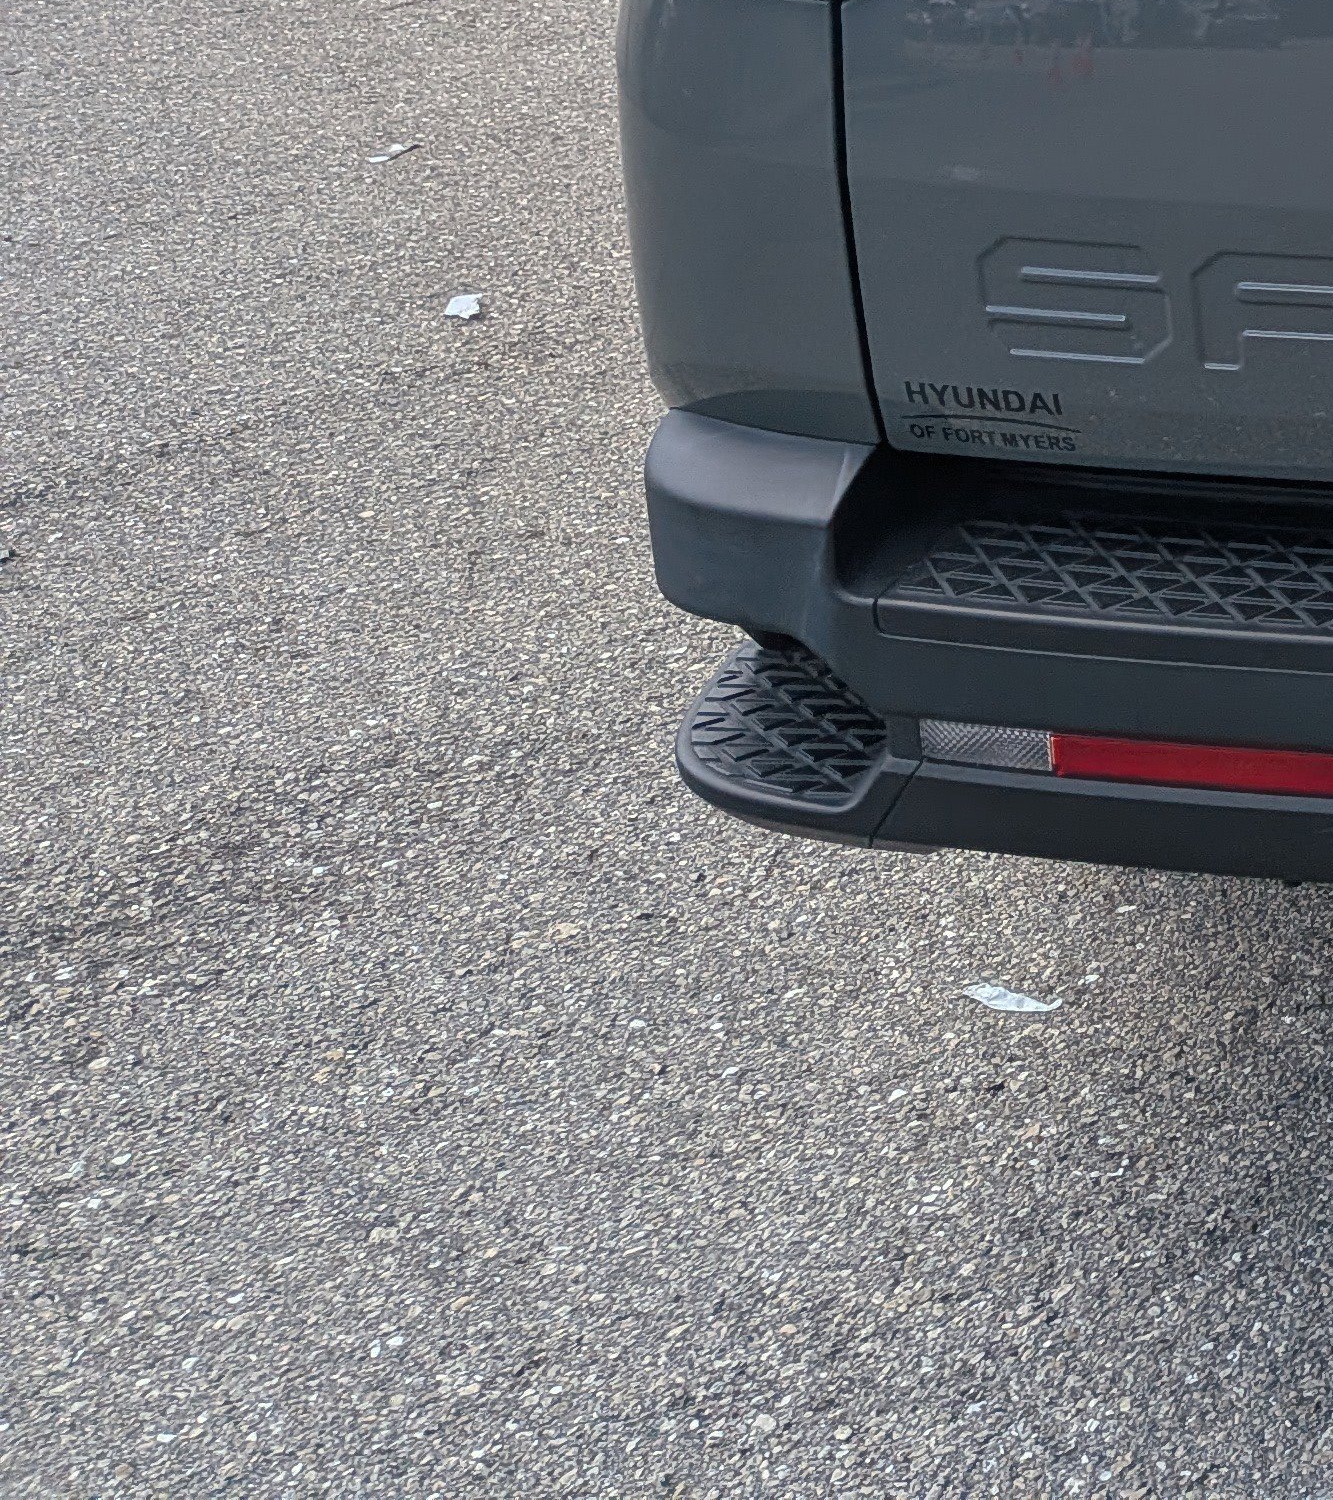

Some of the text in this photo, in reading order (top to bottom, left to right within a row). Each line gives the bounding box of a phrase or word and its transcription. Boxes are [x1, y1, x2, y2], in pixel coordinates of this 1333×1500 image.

[905, 380, 1063, 416] HYUNDAI
[909, 423, 1076, 451] OF FORT MYERS
